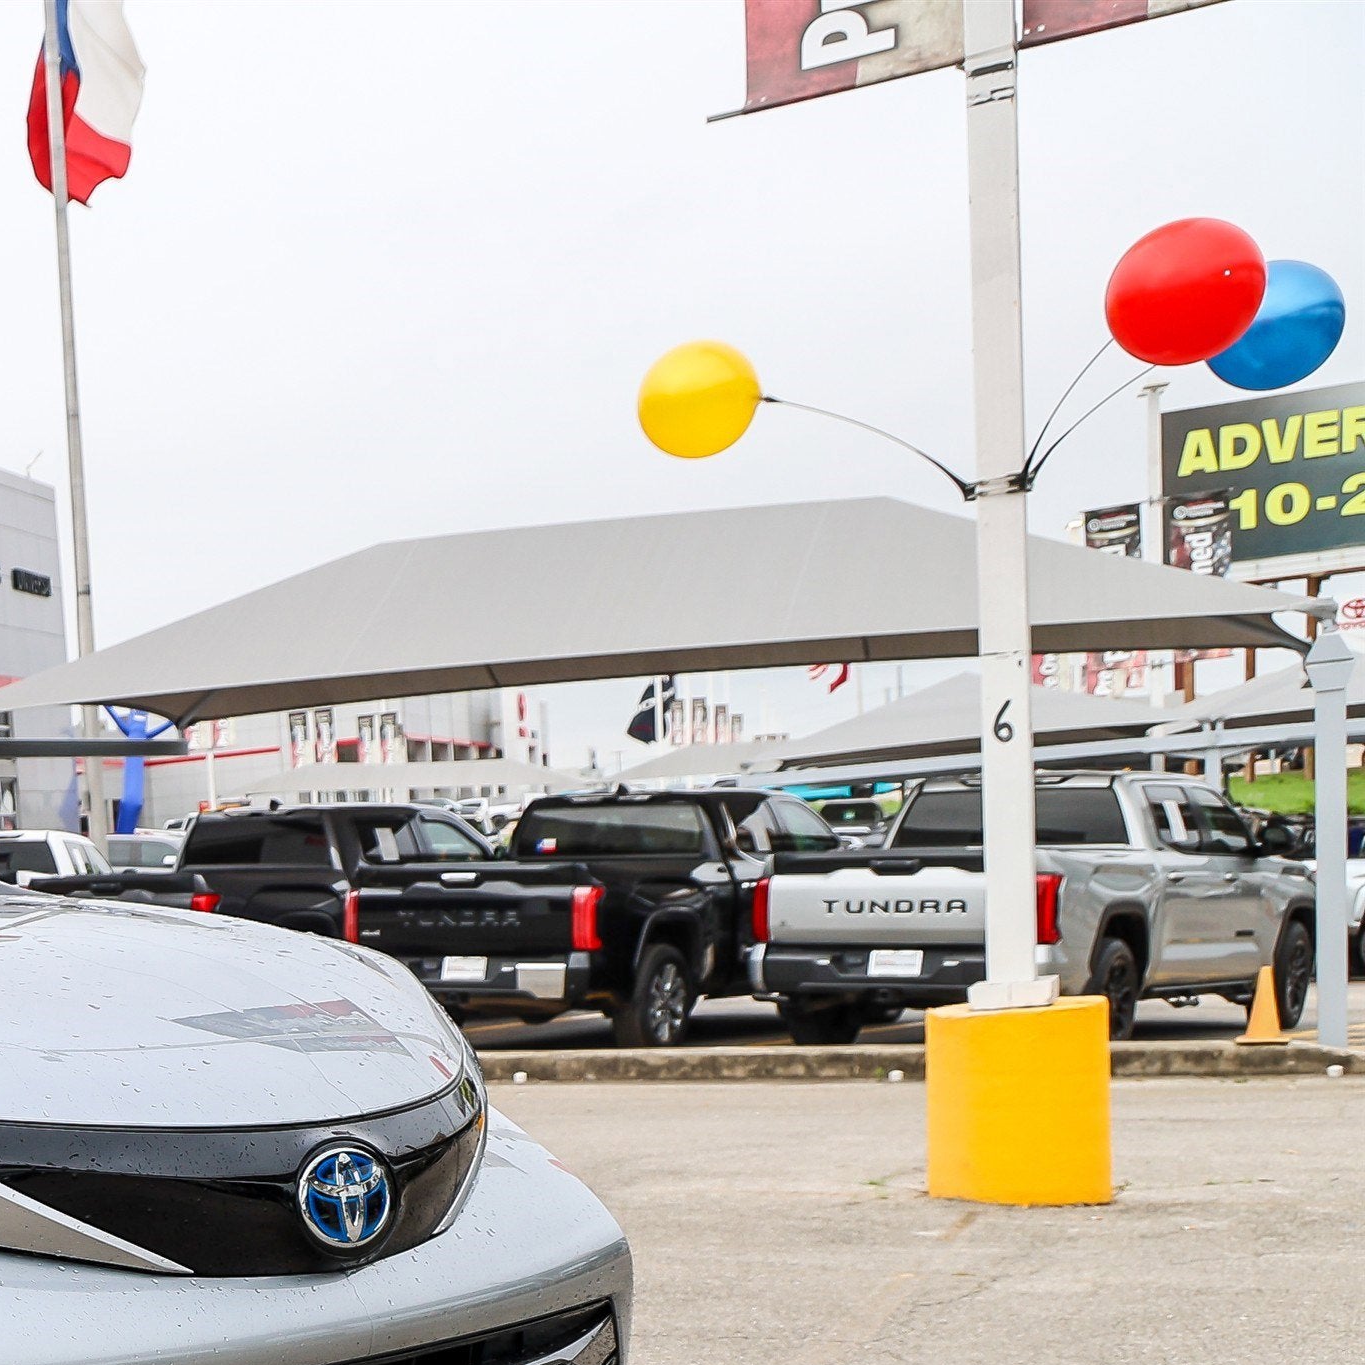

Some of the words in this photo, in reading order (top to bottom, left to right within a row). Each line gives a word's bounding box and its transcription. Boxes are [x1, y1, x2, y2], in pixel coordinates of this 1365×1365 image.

[992, 699, 1015, 743] 6
[823, 899, 968, 915] TUNDRA
[397, 910, 521, 927] TUNDRA
